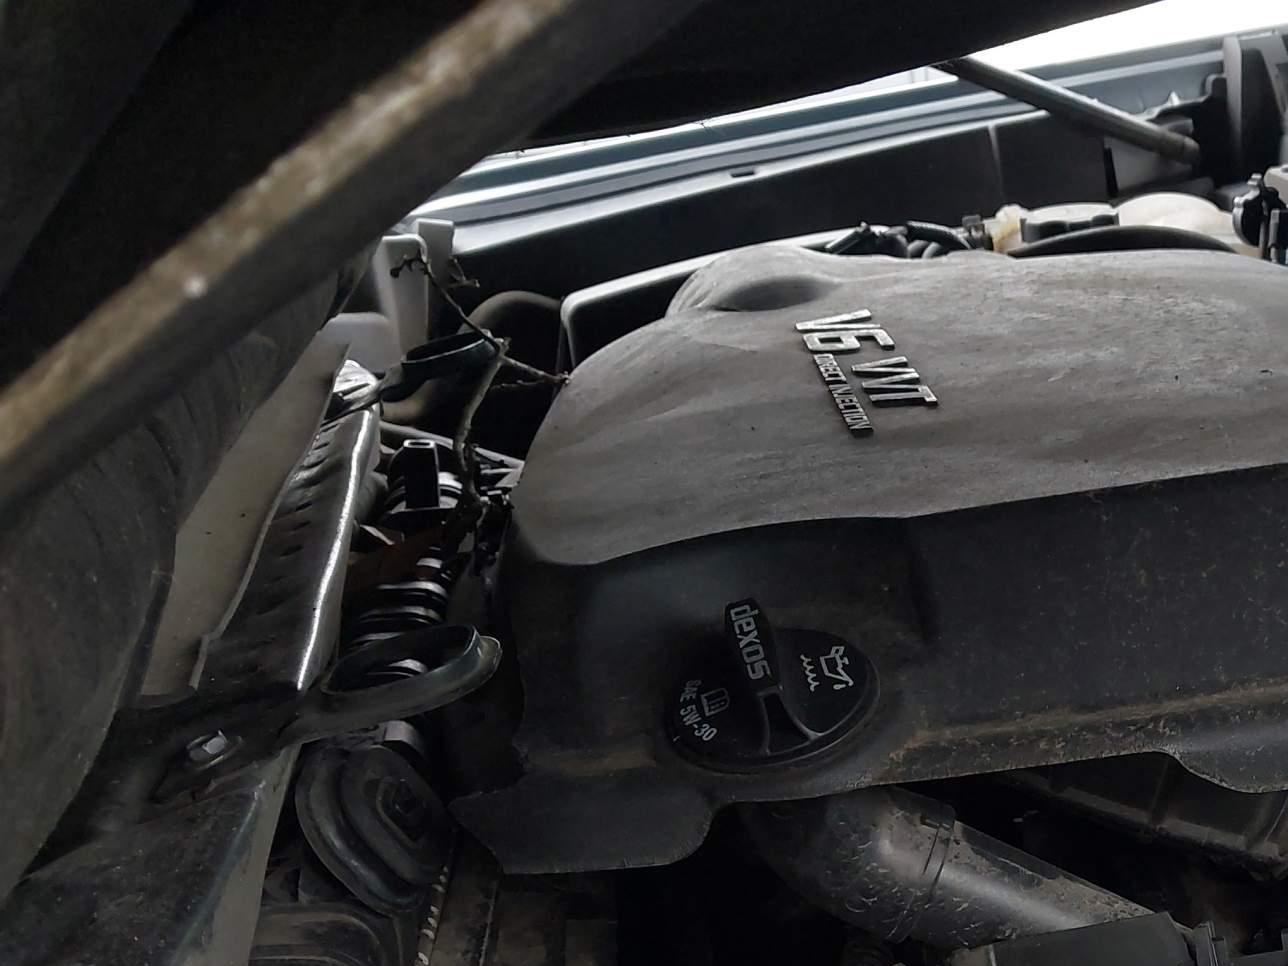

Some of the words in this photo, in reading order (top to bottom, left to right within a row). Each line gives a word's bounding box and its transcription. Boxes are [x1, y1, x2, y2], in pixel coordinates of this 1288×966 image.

[795, 308, 895, 351] V6
[851, 355, 939, 404] VVT
[813, 353, 848, 382] DIRECT
[828, 382, 874, 431] INJECTION
[729, 602, 771, 681] dexos
[679, 679, 702, 703] SAE
[679, 703, 718, 742] 5W-30
